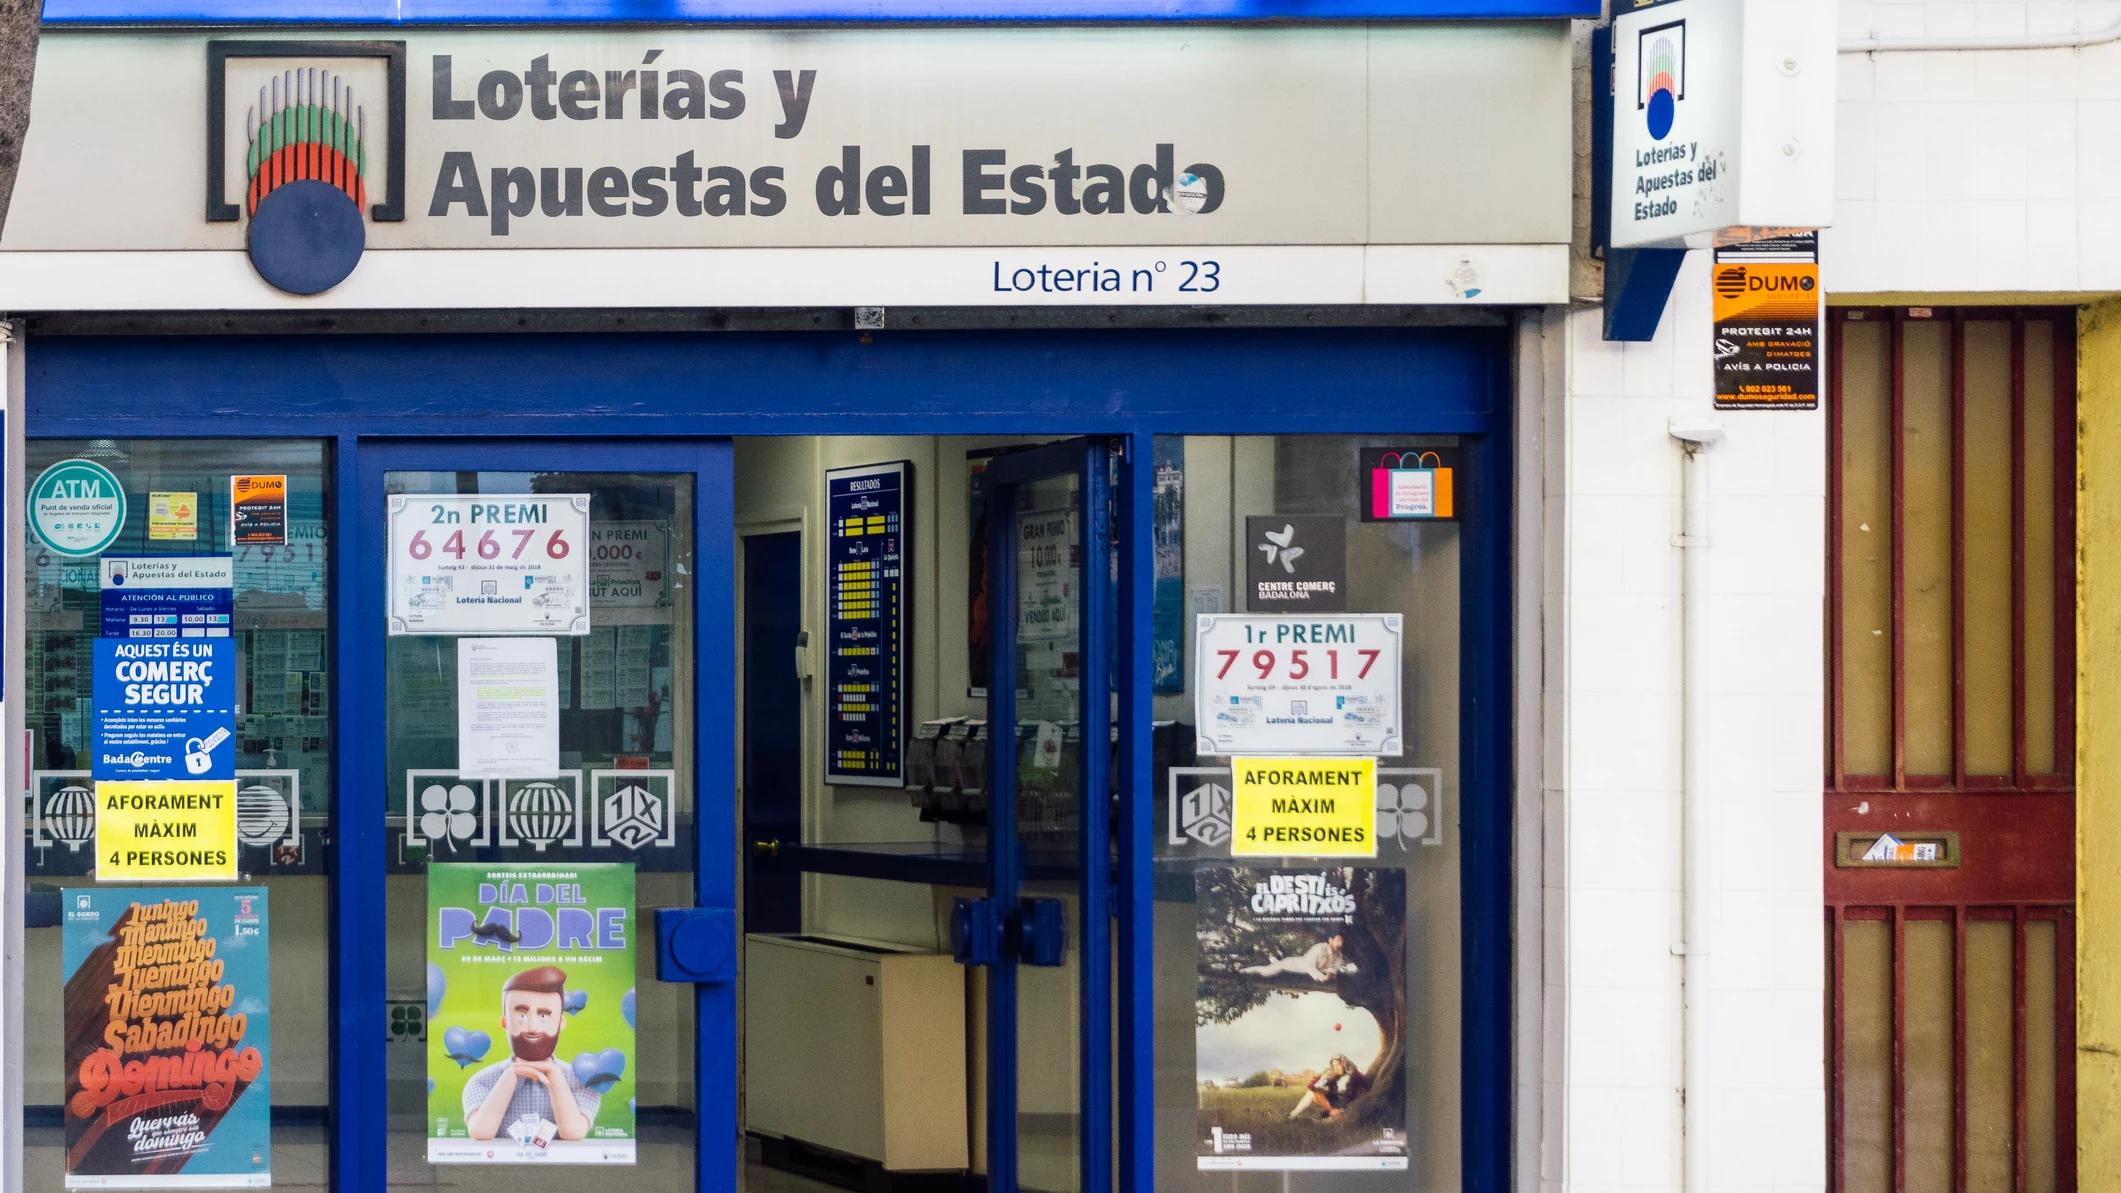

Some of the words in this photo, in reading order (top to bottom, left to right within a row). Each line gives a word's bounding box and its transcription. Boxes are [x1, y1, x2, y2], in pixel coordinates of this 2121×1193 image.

[432, 49, 745, 120] Loterías
[773, 70, 817, 139] y
[1636, 141, 1685, 167] Loterías
[1690, 142, 1697, 162] y
[1636, 169, 1693, 198] Apuestas
[1698, 160, 1716, 182] del
[427, 149, 787, 236] Apuestas
[815, 145, 930, 216] del
[962, 143, 1225, 216] Estado
[1635, 196, 1677, 221] Estado
[994, 261, 1120, 292] Loteria
[1178, 261, 1220, 292] 23
[1749, 276, 1815, 291] DUMO
[1722, 328, 1782, 336] PROTEGIT
[1723, 362, 1750, 371] AVÍS
[1754, 363, 1762, 371] A
[1766, 363, 1811, 371] POLICIA
[1716, 393, 1815, 402] www.dumoseguridad.com
[51, 480, 100, 498] ATM
[251, 481, 282, 489] DUMO
[850, 479, 880, 492] RESULTADOS
[432, 504, 460, 525] 2n
[470, 503, 548, 524] PREMI
[607, 530, 647, 540] PREMI
[1024, 522, 1045, 540] GRAN
[409, 529, 570, 561] 64676
[636, 551, 642, 559] €
[132, 562, 169, 570] Loterías
[172, 563, 177, 571] y
[132, 572, 175, 580] Apuestas
[195, 570, 226, 578] Estado
[611, 584, 642, 597] AQUÍ
[1258, 581, 1294, 591] CENTRE
[1296, 581, 1336, 593] COMERÇ
[1258, 590, 1310, 600] BADALONA
[456, 596, 485, 604] Lotería
[487, 596, 521, 604] Nacional
[1245, 624, 1267, 643] 1r
[1277, 623, 1355, 643] PREMI
[115, 644, 170, 658] AQUEST
[173, 641, 189, 657] ÉS
[193, 644, 213, 657] UN
[1216, 649, 1382, 680] 79517
[115, 661, 213, 687] COMERÇ
[125, 684, 203, 705] SEGUR
[1245, 770, 1362, 785] AFORAMENT
[107, 794, 223, 810] AFORAMENT
[1272, 795, 1335, 814] MÀXIM
[134, 819, 197, 837] MÀXIM
[1246, 827, 1257, 841] 4
[1264, 827, 1365, 842] PERSONES
[110, 851, 120, 865] 4
[127, 851, 226, 866] PERSONES
[479, 880, 529, 904] DÍA
[536, 883, 586, 904] DEL
[1256, 882, 1271, 894] EL
[1270, 872, 1327, 896] DESTÍ
[1325, 883, 1338, 896] ÉS
[241, 900, 252, 913] 5
[1251, 888, 1356, 915] CAPRITXÓS
[439, 906, 626, 953] PADRE
[104, 1011, 247, 1058] Sabadingo
[71, 1039, 263, 1118] Domingo
[128, 1110, 200, 1140] Querrás
[134, 1131, 205, 1150] domingo
